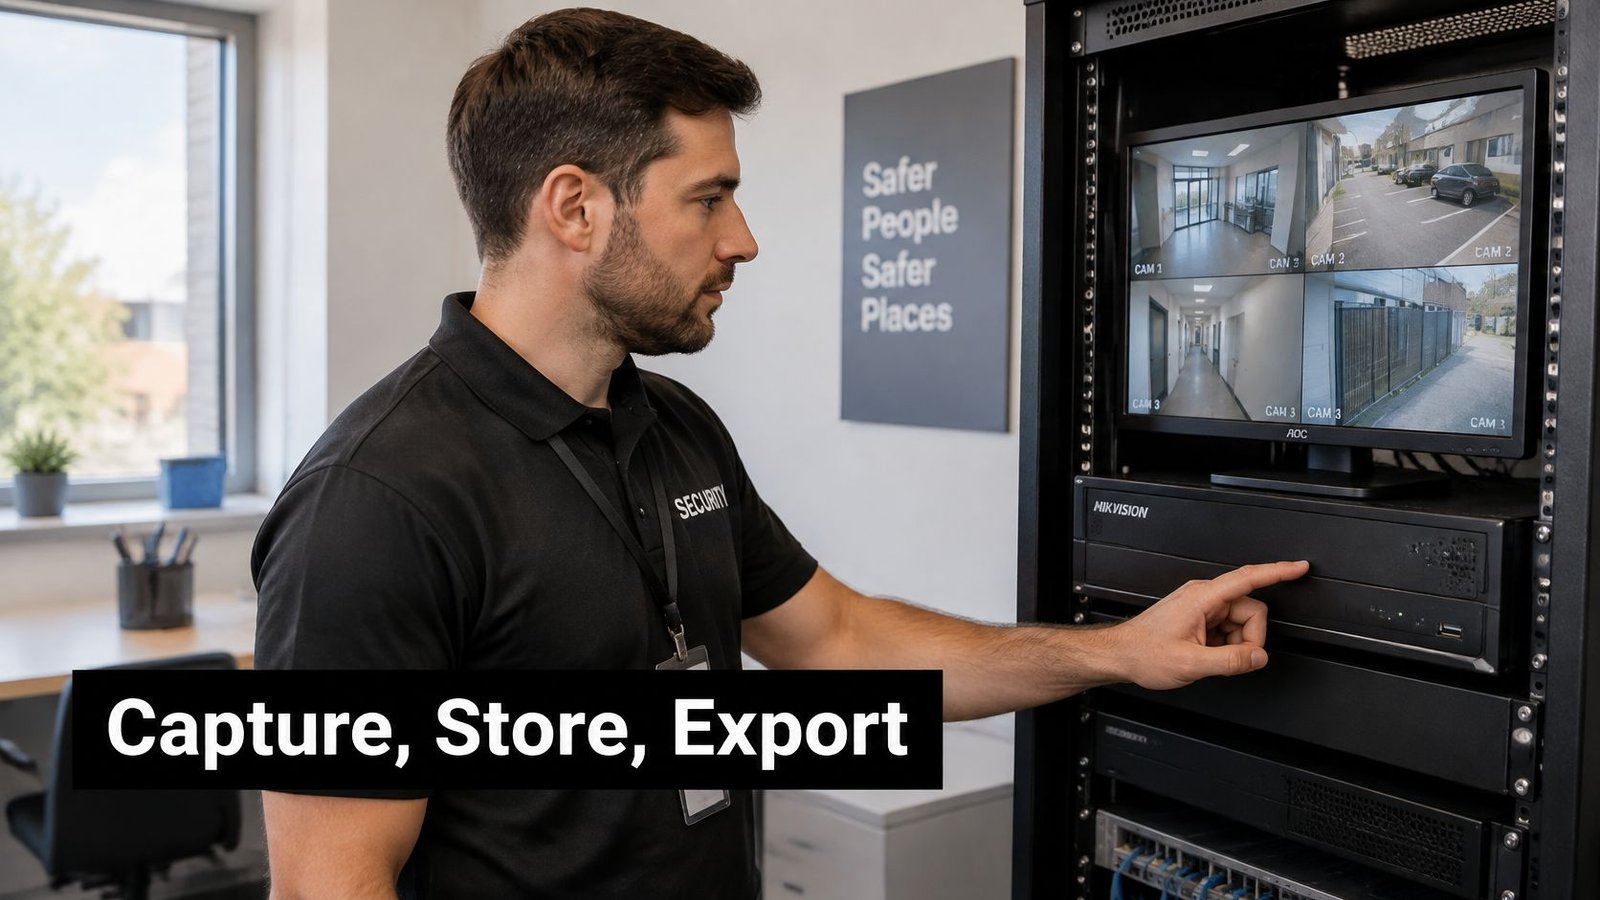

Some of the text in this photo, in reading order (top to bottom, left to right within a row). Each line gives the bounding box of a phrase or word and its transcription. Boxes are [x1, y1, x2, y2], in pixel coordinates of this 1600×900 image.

[862, 155, 938, 198] Safer
[862, 197, 959, 244] People
[1504, 245, 1512, 257] 2
[1311, 252, 1345, 266] CAM 2
[861, 249, 937, 289] Safer
[1134, 262, 1155, 275] CAM
[861, 295, 953, 333] Places
[1154, 399, 1160, 410] 3
[1289, 407, 1296, 418] 3
[1307, 406, 1342, 420] CAM 3
[1470, 416, 1506, 430] CAM 3
[1286, 428, 1308, 439] AOC
[674, 483, 729, 520] SECURITY
